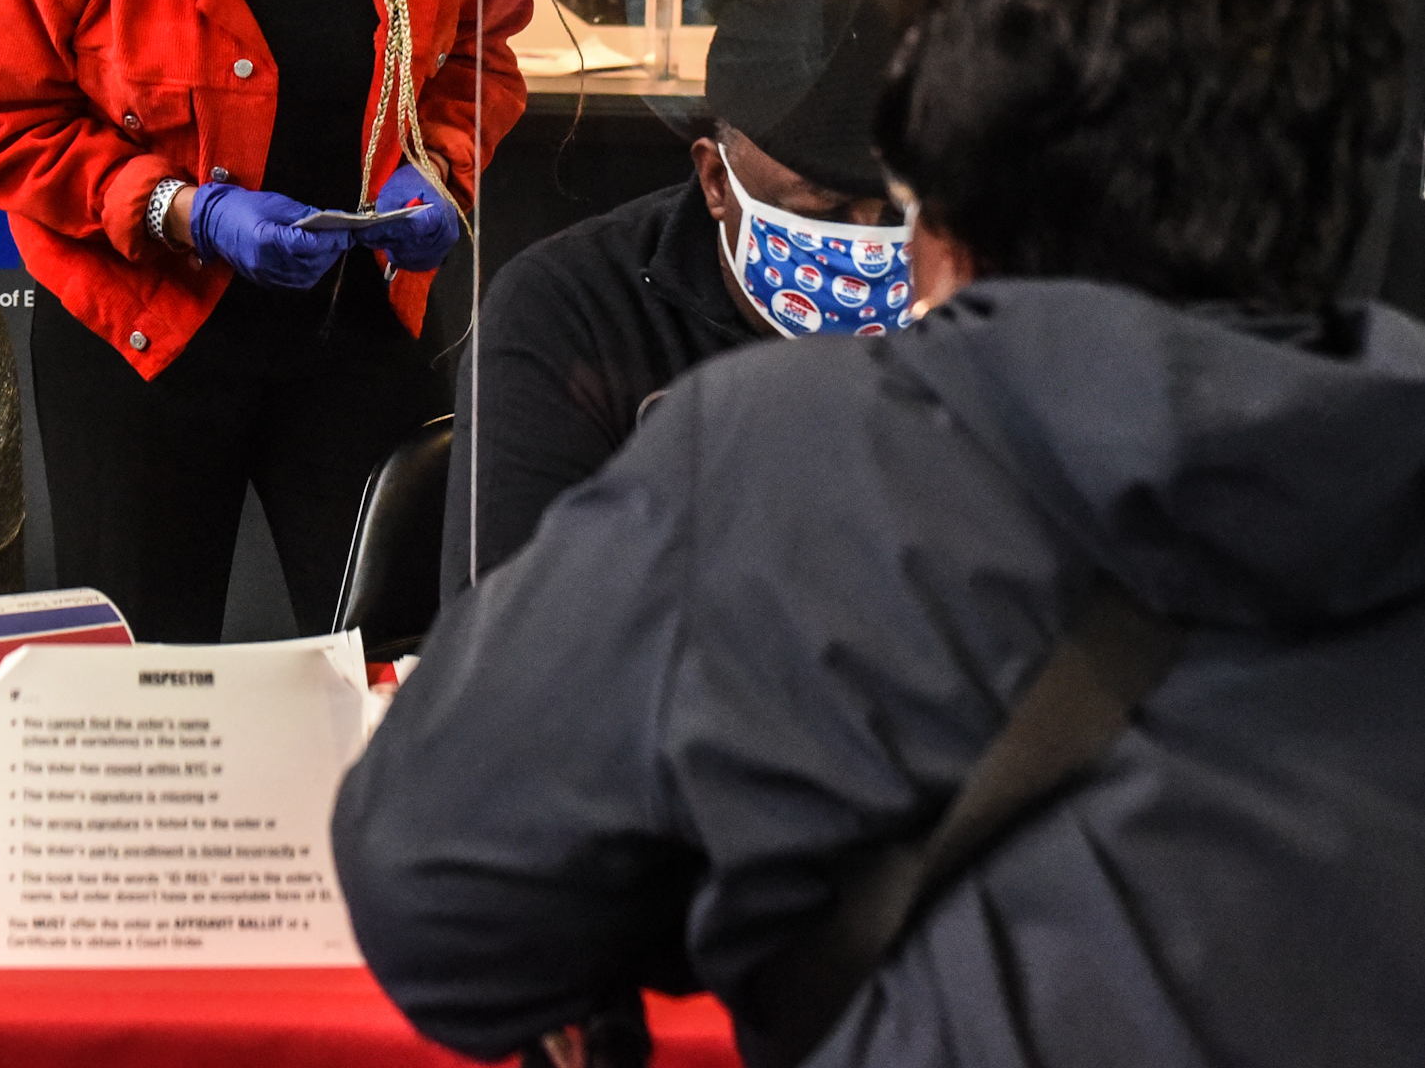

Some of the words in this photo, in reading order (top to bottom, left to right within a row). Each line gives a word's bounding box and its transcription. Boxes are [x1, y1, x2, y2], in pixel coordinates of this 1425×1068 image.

[0, 290, 19, 307] of
[138, 670, 214, 685] INSPECTOR
[47, 717, 85, 730] cannot
[90, 717, 111, 730] find
[115, 717, 133, 730] the
[178, 719, 210, 730] name
[158, 736, 175, 748] the
[179, 736, 207, 748] book
[24, 763, 43, 775] The
[146, 763, 180, 775] within
[184, 763, 207, 775] NYC
[24, 790, 42, 803] The
[24, 817, 43, 830] The
[211, 817, 229, 830] the
[23, 844, 42, 857] The
[23, 871, 42, 884] The
[46, 871, 74, 884] book
[102, 871, 120, 884] the
[264, 871, 281, 884] the
[60, 889, 78, 902] but
[161, 889, 187, 902] have
[32, 916, 66, 929] MUST
[101, 916, 119, 929] the
[174, 916, 234, 929] AFFIDAVIT
[238, 916, 283, 929] BALLOT
